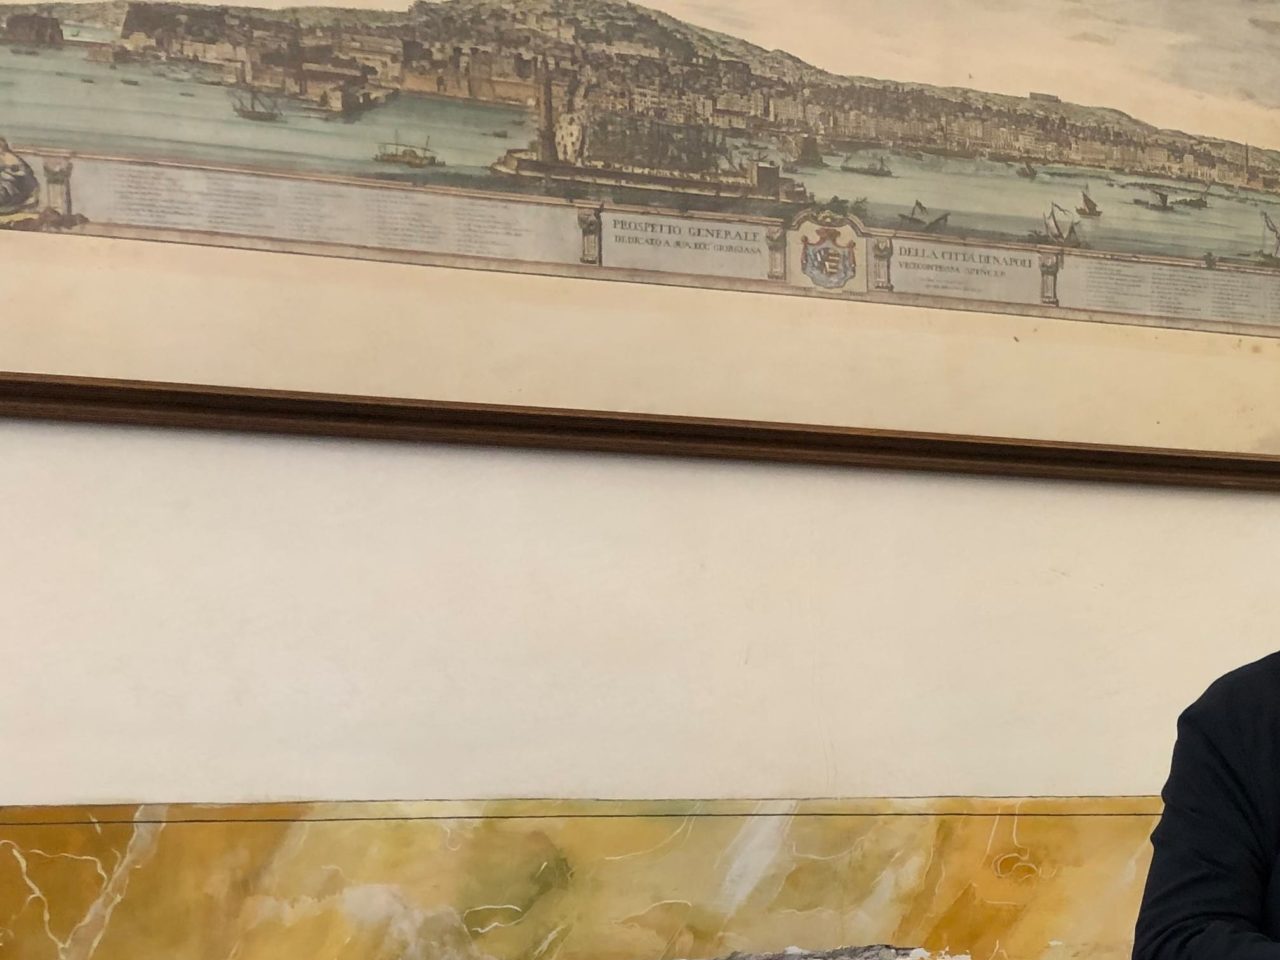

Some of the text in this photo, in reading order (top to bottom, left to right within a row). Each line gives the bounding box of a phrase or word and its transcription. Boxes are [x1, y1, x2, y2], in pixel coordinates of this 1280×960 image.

[613, 219, 759, 241] PROSPETTO GENERALE
[899, 247, 938, 259] DELLA
[991, 255, 1032, 268] NAPOLI
